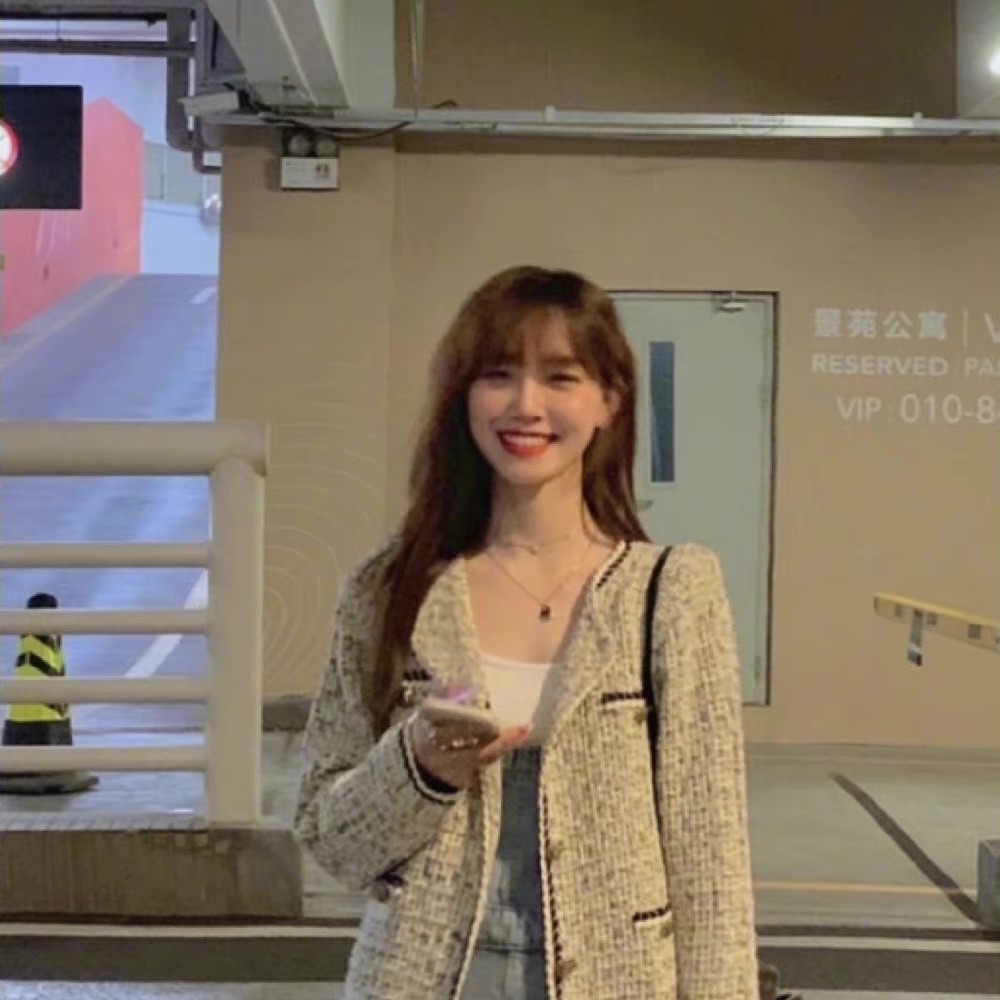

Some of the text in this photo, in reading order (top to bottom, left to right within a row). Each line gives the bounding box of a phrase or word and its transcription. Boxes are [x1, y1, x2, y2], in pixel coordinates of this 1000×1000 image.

[811, 353, 1000, 377] RESERVED PA
[900, 392, 1000, 424] 010-8
